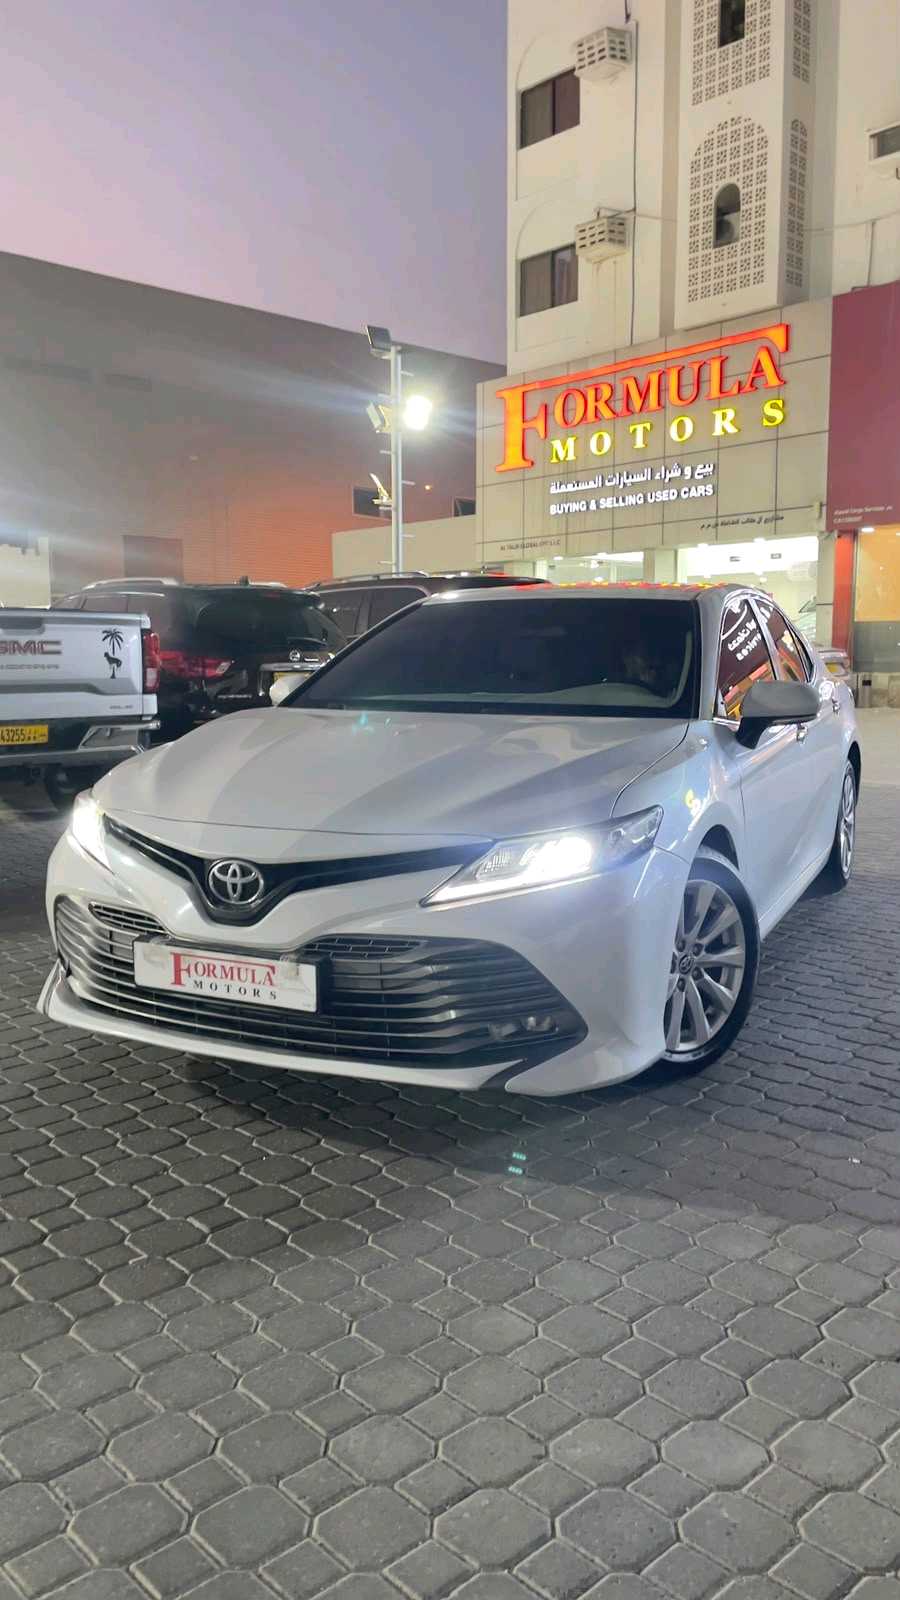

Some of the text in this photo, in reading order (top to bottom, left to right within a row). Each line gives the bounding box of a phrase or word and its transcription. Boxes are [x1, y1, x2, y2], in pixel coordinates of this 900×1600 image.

[495, 323, 790, 472] FORMULA
[550, 398, 786, 464] MOTORS
[550, 463, 714, 494] بيع و شراء السيارات المستعملة
[550, 484, 714, 515] BUYING & SELLING USED CARS
[170, 952, 277, 987] FORMULA
[193, 979, 277, 1000] MOTORS
